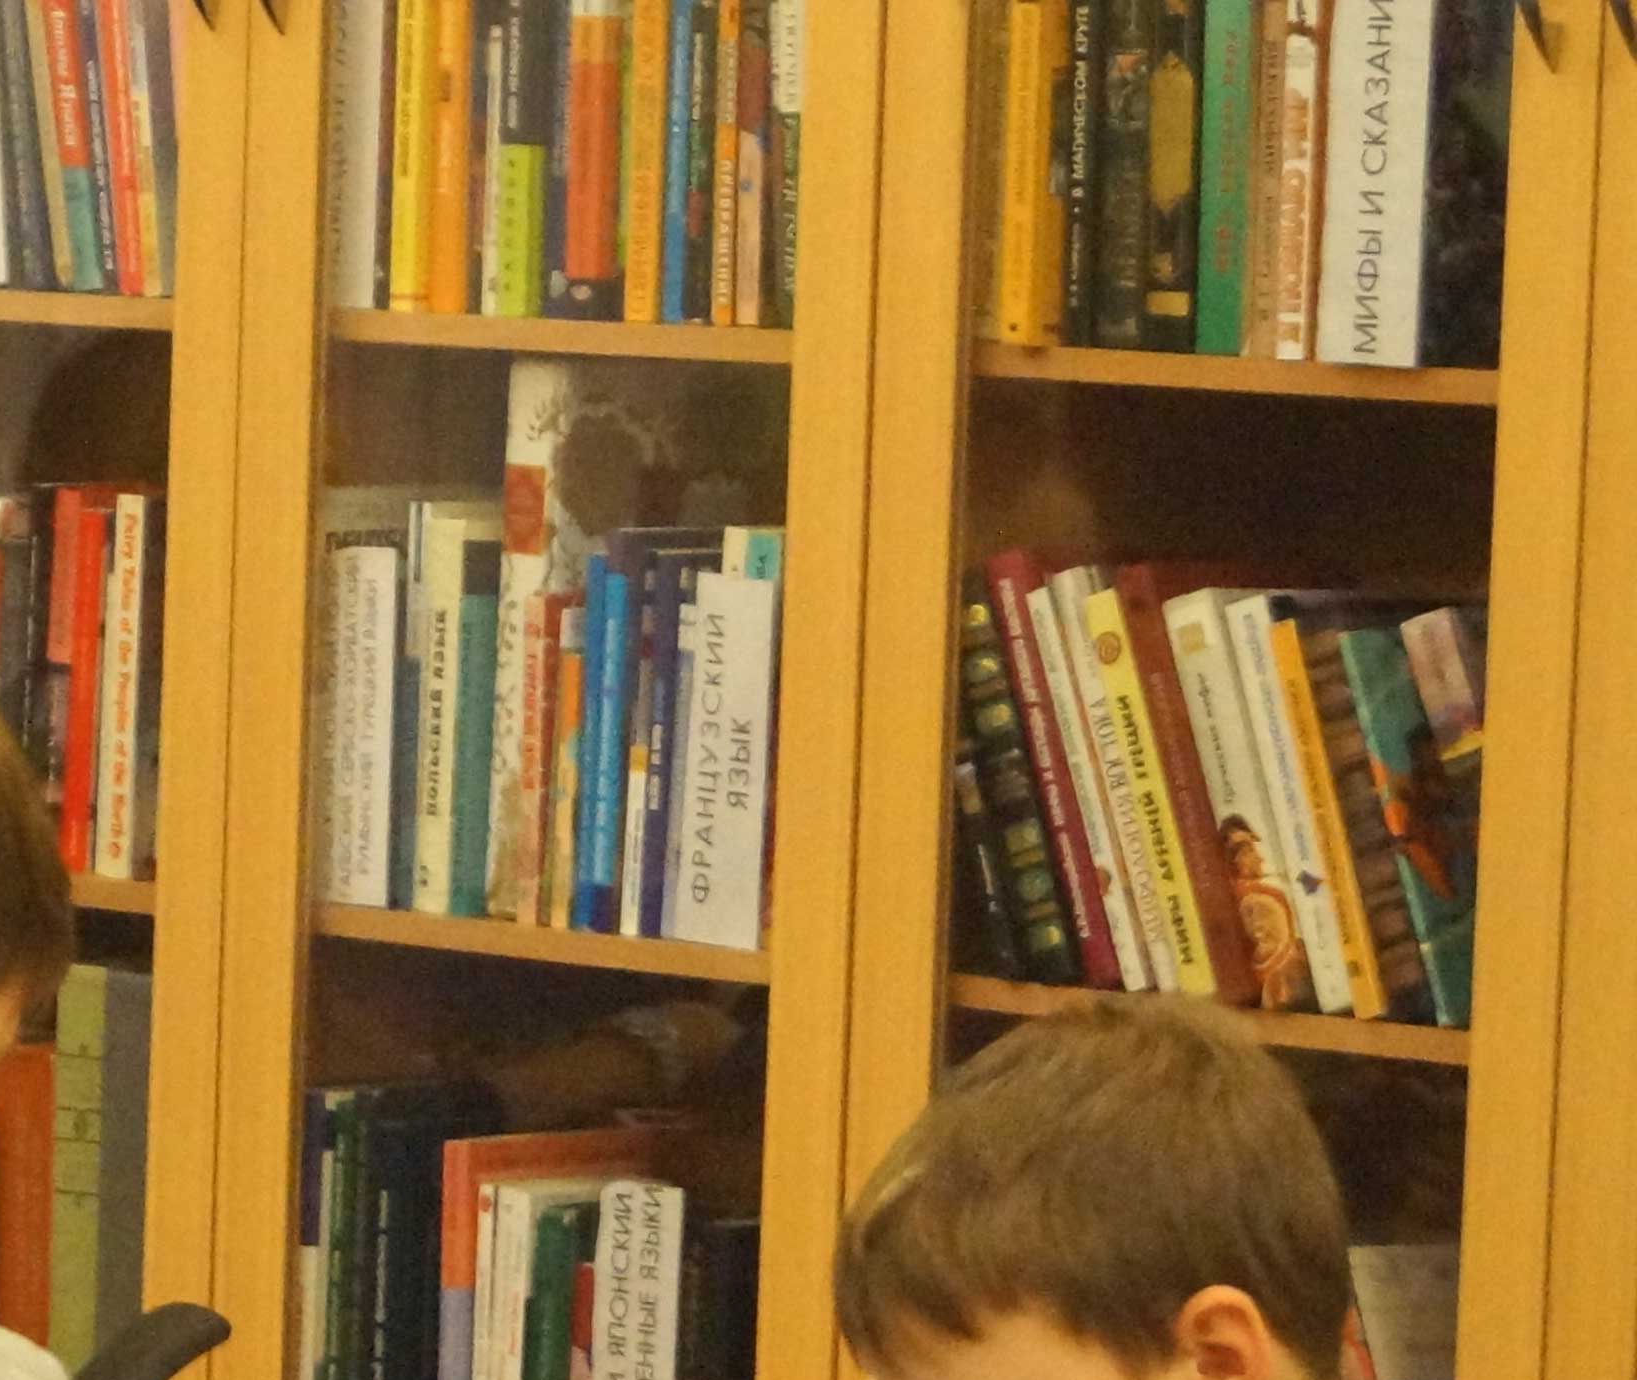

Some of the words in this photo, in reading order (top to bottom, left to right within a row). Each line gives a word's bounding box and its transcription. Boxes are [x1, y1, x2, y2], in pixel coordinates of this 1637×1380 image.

[1359, 0, 1395, 175] СКАЗАНИ
[1357, 189, 1386, 216] И
[1352, 229, 1383, 354] МИФЫ
[725, 716, 752, 811] ЯЗЫК
